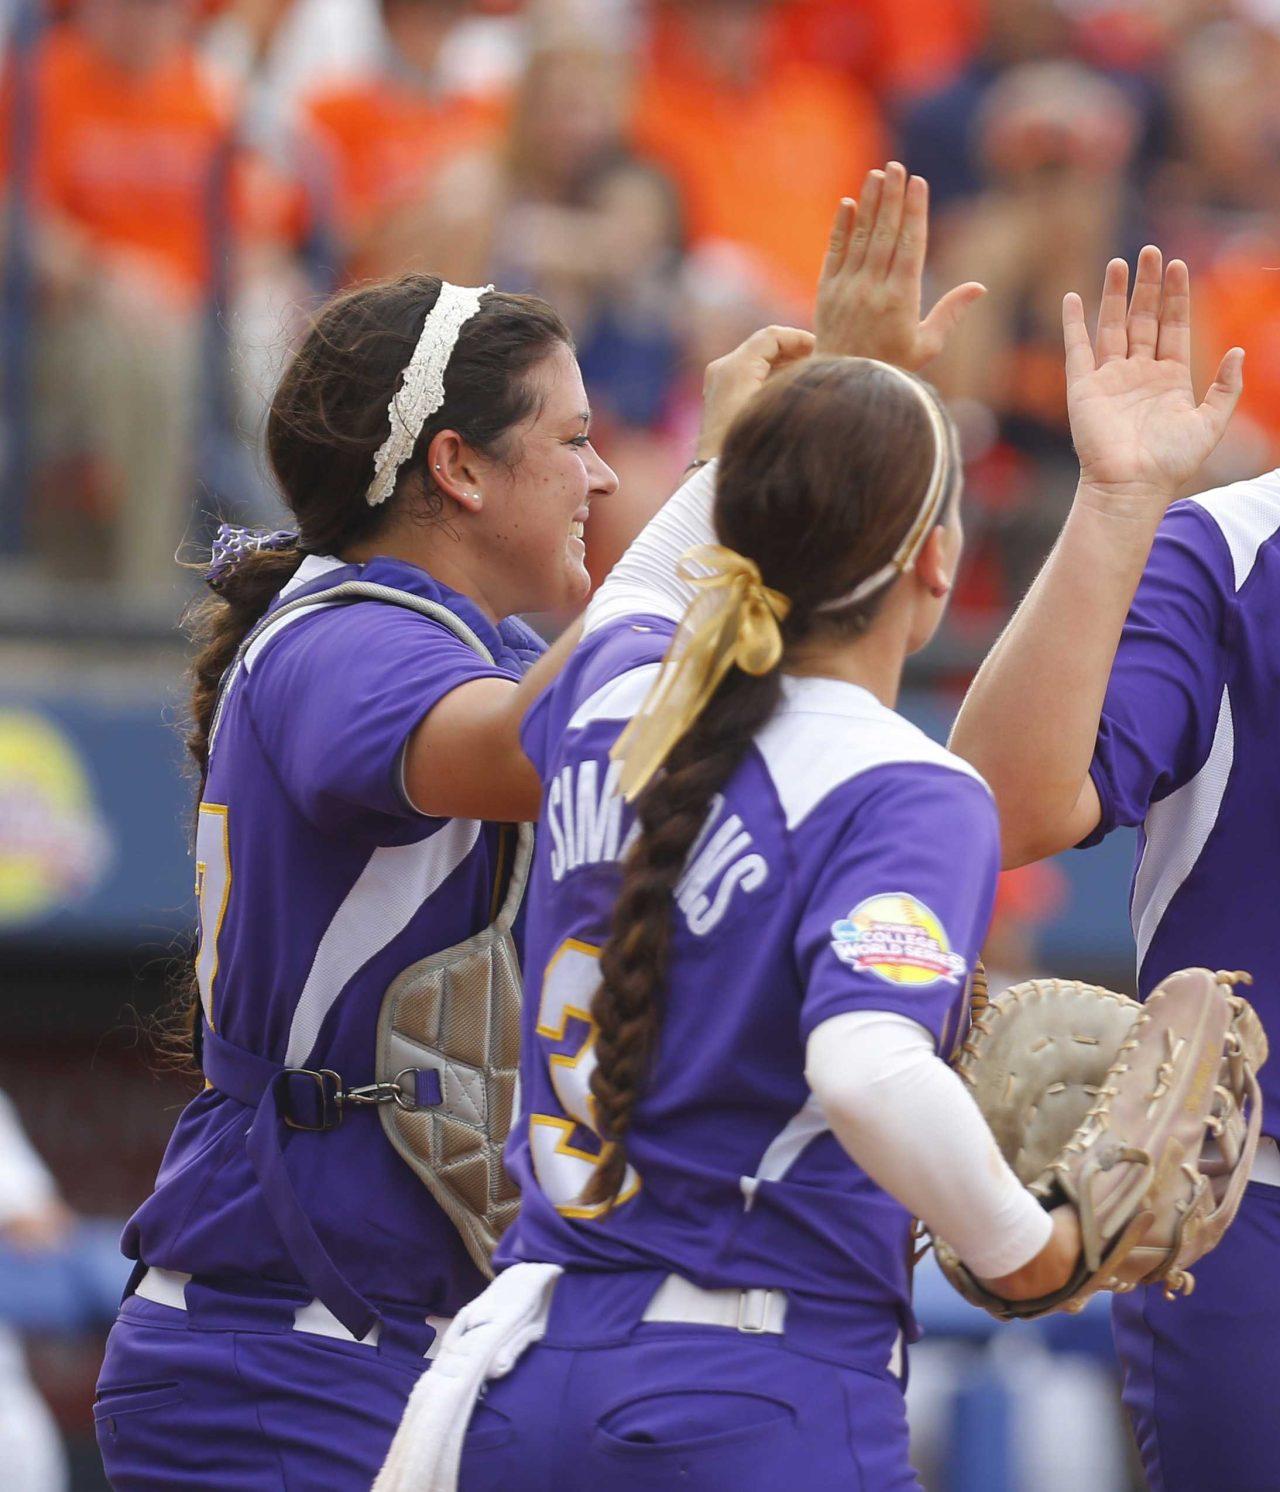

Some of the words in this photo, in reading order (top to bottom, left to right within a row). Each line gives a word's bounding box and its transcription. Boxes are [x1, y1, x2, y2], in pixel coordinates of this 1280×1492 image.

[548, 759, 768, 936] SIMNS
[835, 941, 903, 958] WORLD
[861, 929, 943, 953] COLLEGE
